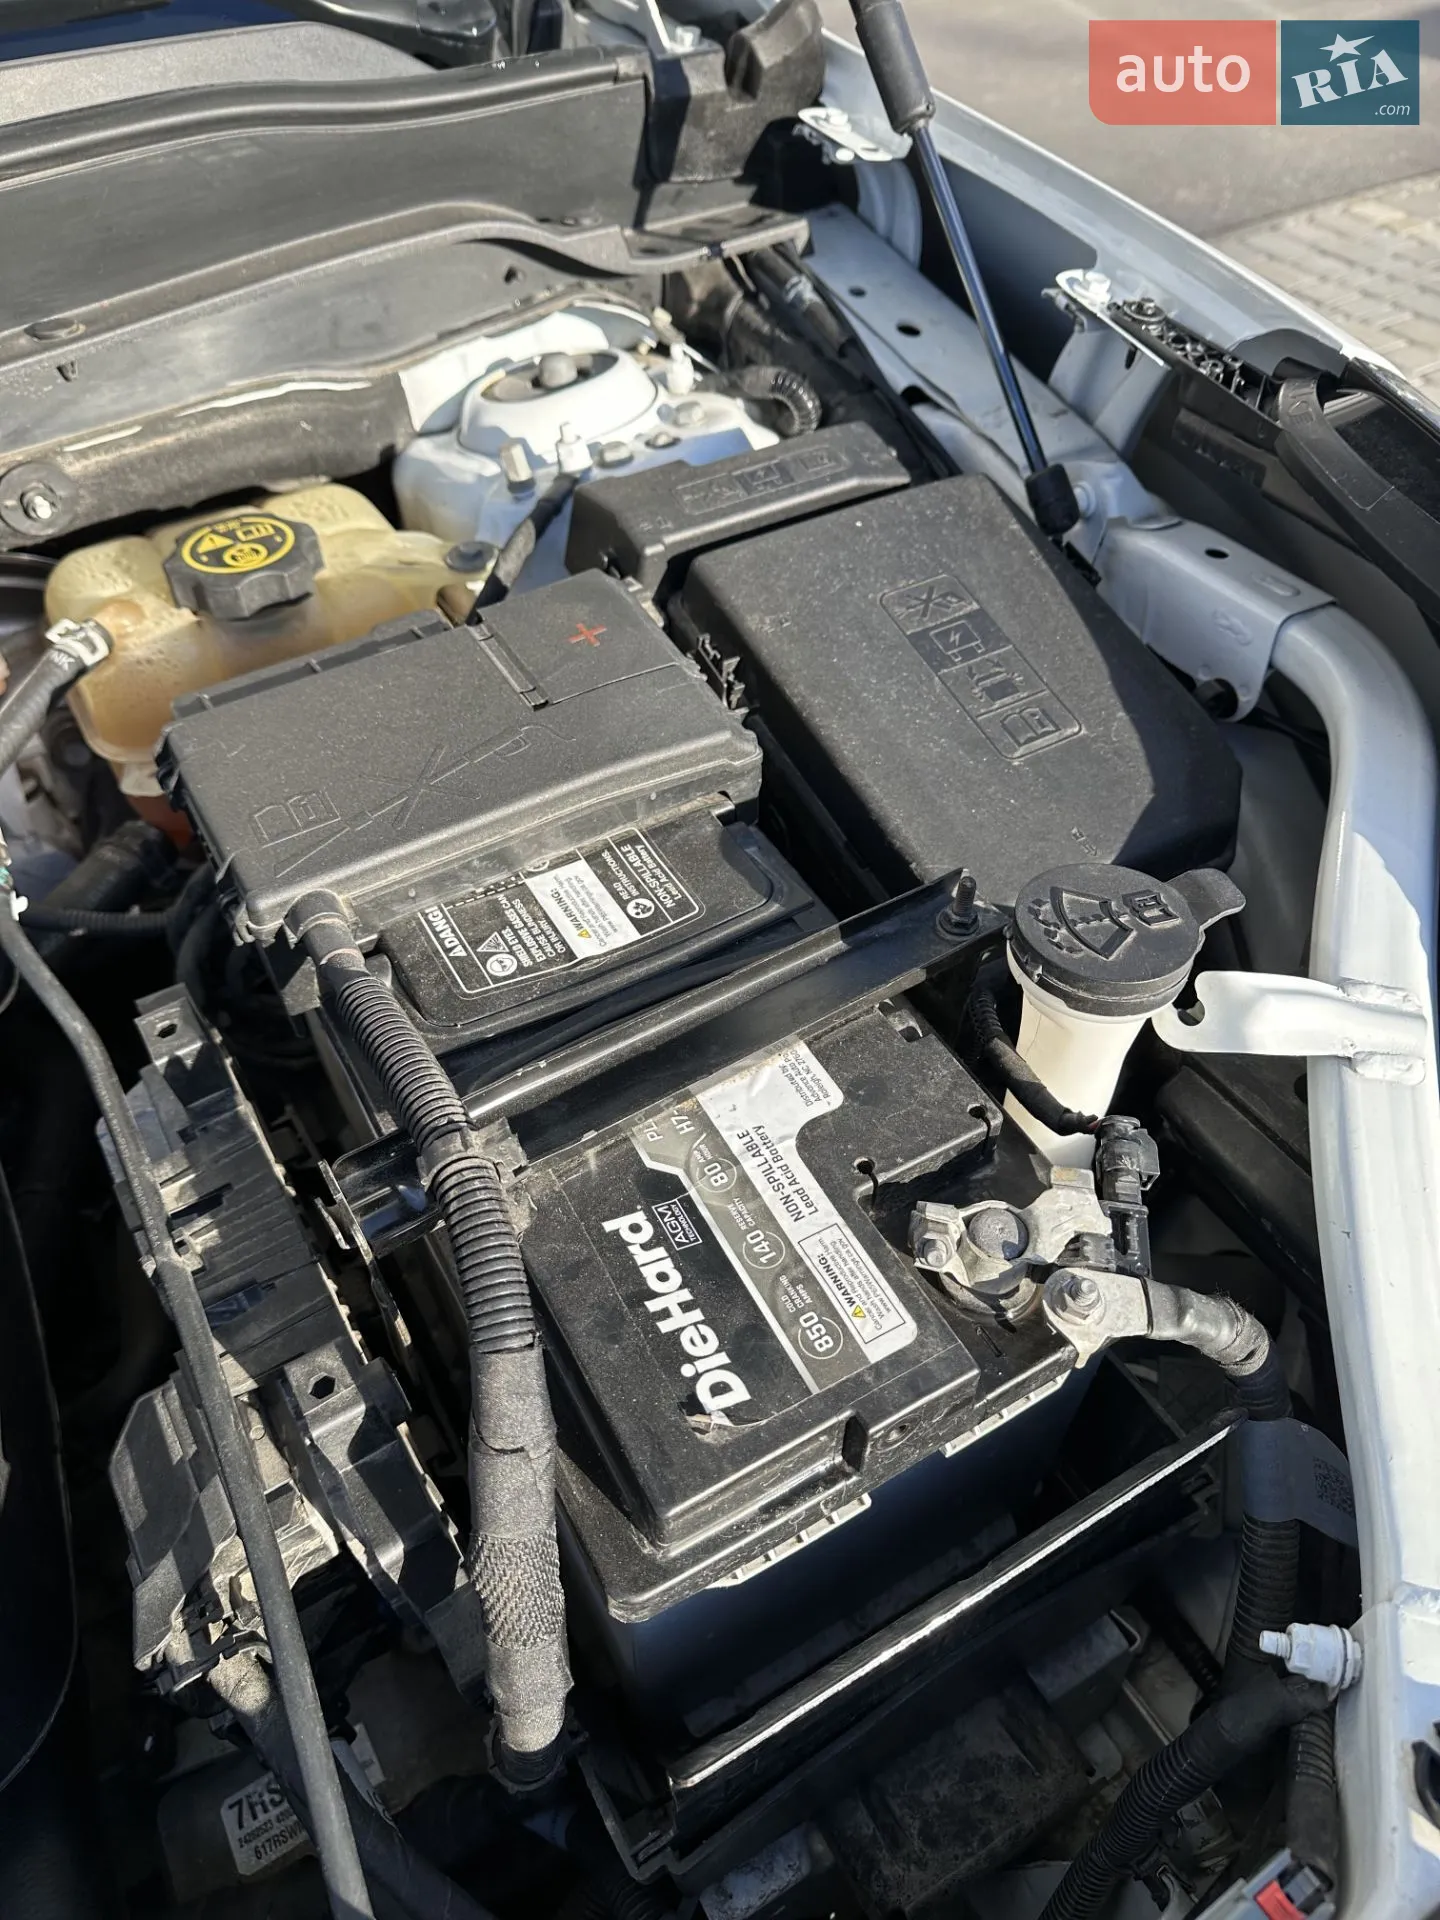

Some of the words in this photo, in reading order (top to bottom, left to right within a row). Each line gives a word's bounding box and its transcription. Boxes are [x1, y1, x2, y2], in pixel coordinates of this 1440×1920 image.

[634, 843, 657, 869] Battery
[619, 843, 676, 908] NON-SPILLABLE
[651, 867, 668, 883] Acid
[612, 880, 631, 900] READ
[663, 881, 682, 900] Lead
[503, 906, 524, 930] GASES
[510, 897, 541, 935] BLINDNESS
[548, 887, 584, 931] WARNING:
[511, 942, 533, 967] SHIELD
[516, 926, 546, 962] EXPLOSIVE
[534, 932, 556, 957] CAUSE
[552, 940, 566, 953] OR
[777, 1063, 789, 1073] by:
[779, 1051, 791, 1063] Pa
[787, 1061, 802, 1077] Auto
[788, 1048, 806, 1065] 2760
[800, 1064, 812, 1074] NC
[783, 1072, 814, 1107] Distributed
[798, 1075, 822, 1101] Advance
[808, 1073, 831, 1098] Raleigh,
[692, 1148, 706, 1163] AMP
[697, 1142, 714, 1159] HOUR
[751, 1123, 784, 1163] Battery
[702, 1160, 729, 1188] 80
[735, 1129, 806, 1222] NON-SPILLABLE
[776, 1162, 800, 1186] Acid
[732, 1196, 756, 1226] CAPACITY
[792, 1186, 818, 1215] Lead
[656, 1204, 689, 1244] AGM
[669, 1202, 696, 1241] TECHNOLOGY
[725, 1202, 748, 1230] RESERVE
[744, 1227, 777, 1265] 140
[816, 1252, 856, 1307] WARNING:
[828, 1254, 858, 1293] Reproductive
[846, 1266, 859, 1280] after
[778, 1273, 805, 1308] CRANKING
[794, 1282, 813, 1304] AMPS
[854, 1292, 867, 1306] and
[855, 1280, 872, 1300] hands
[600, 1208, 752, 1413] DieHard
[780, 1293, 796, 1313] COLD
[868, 1299, 885, 1319] Wash
[797, 1308, 835, 1353] 850
[863, 1306, 883, 1331] Cancer
